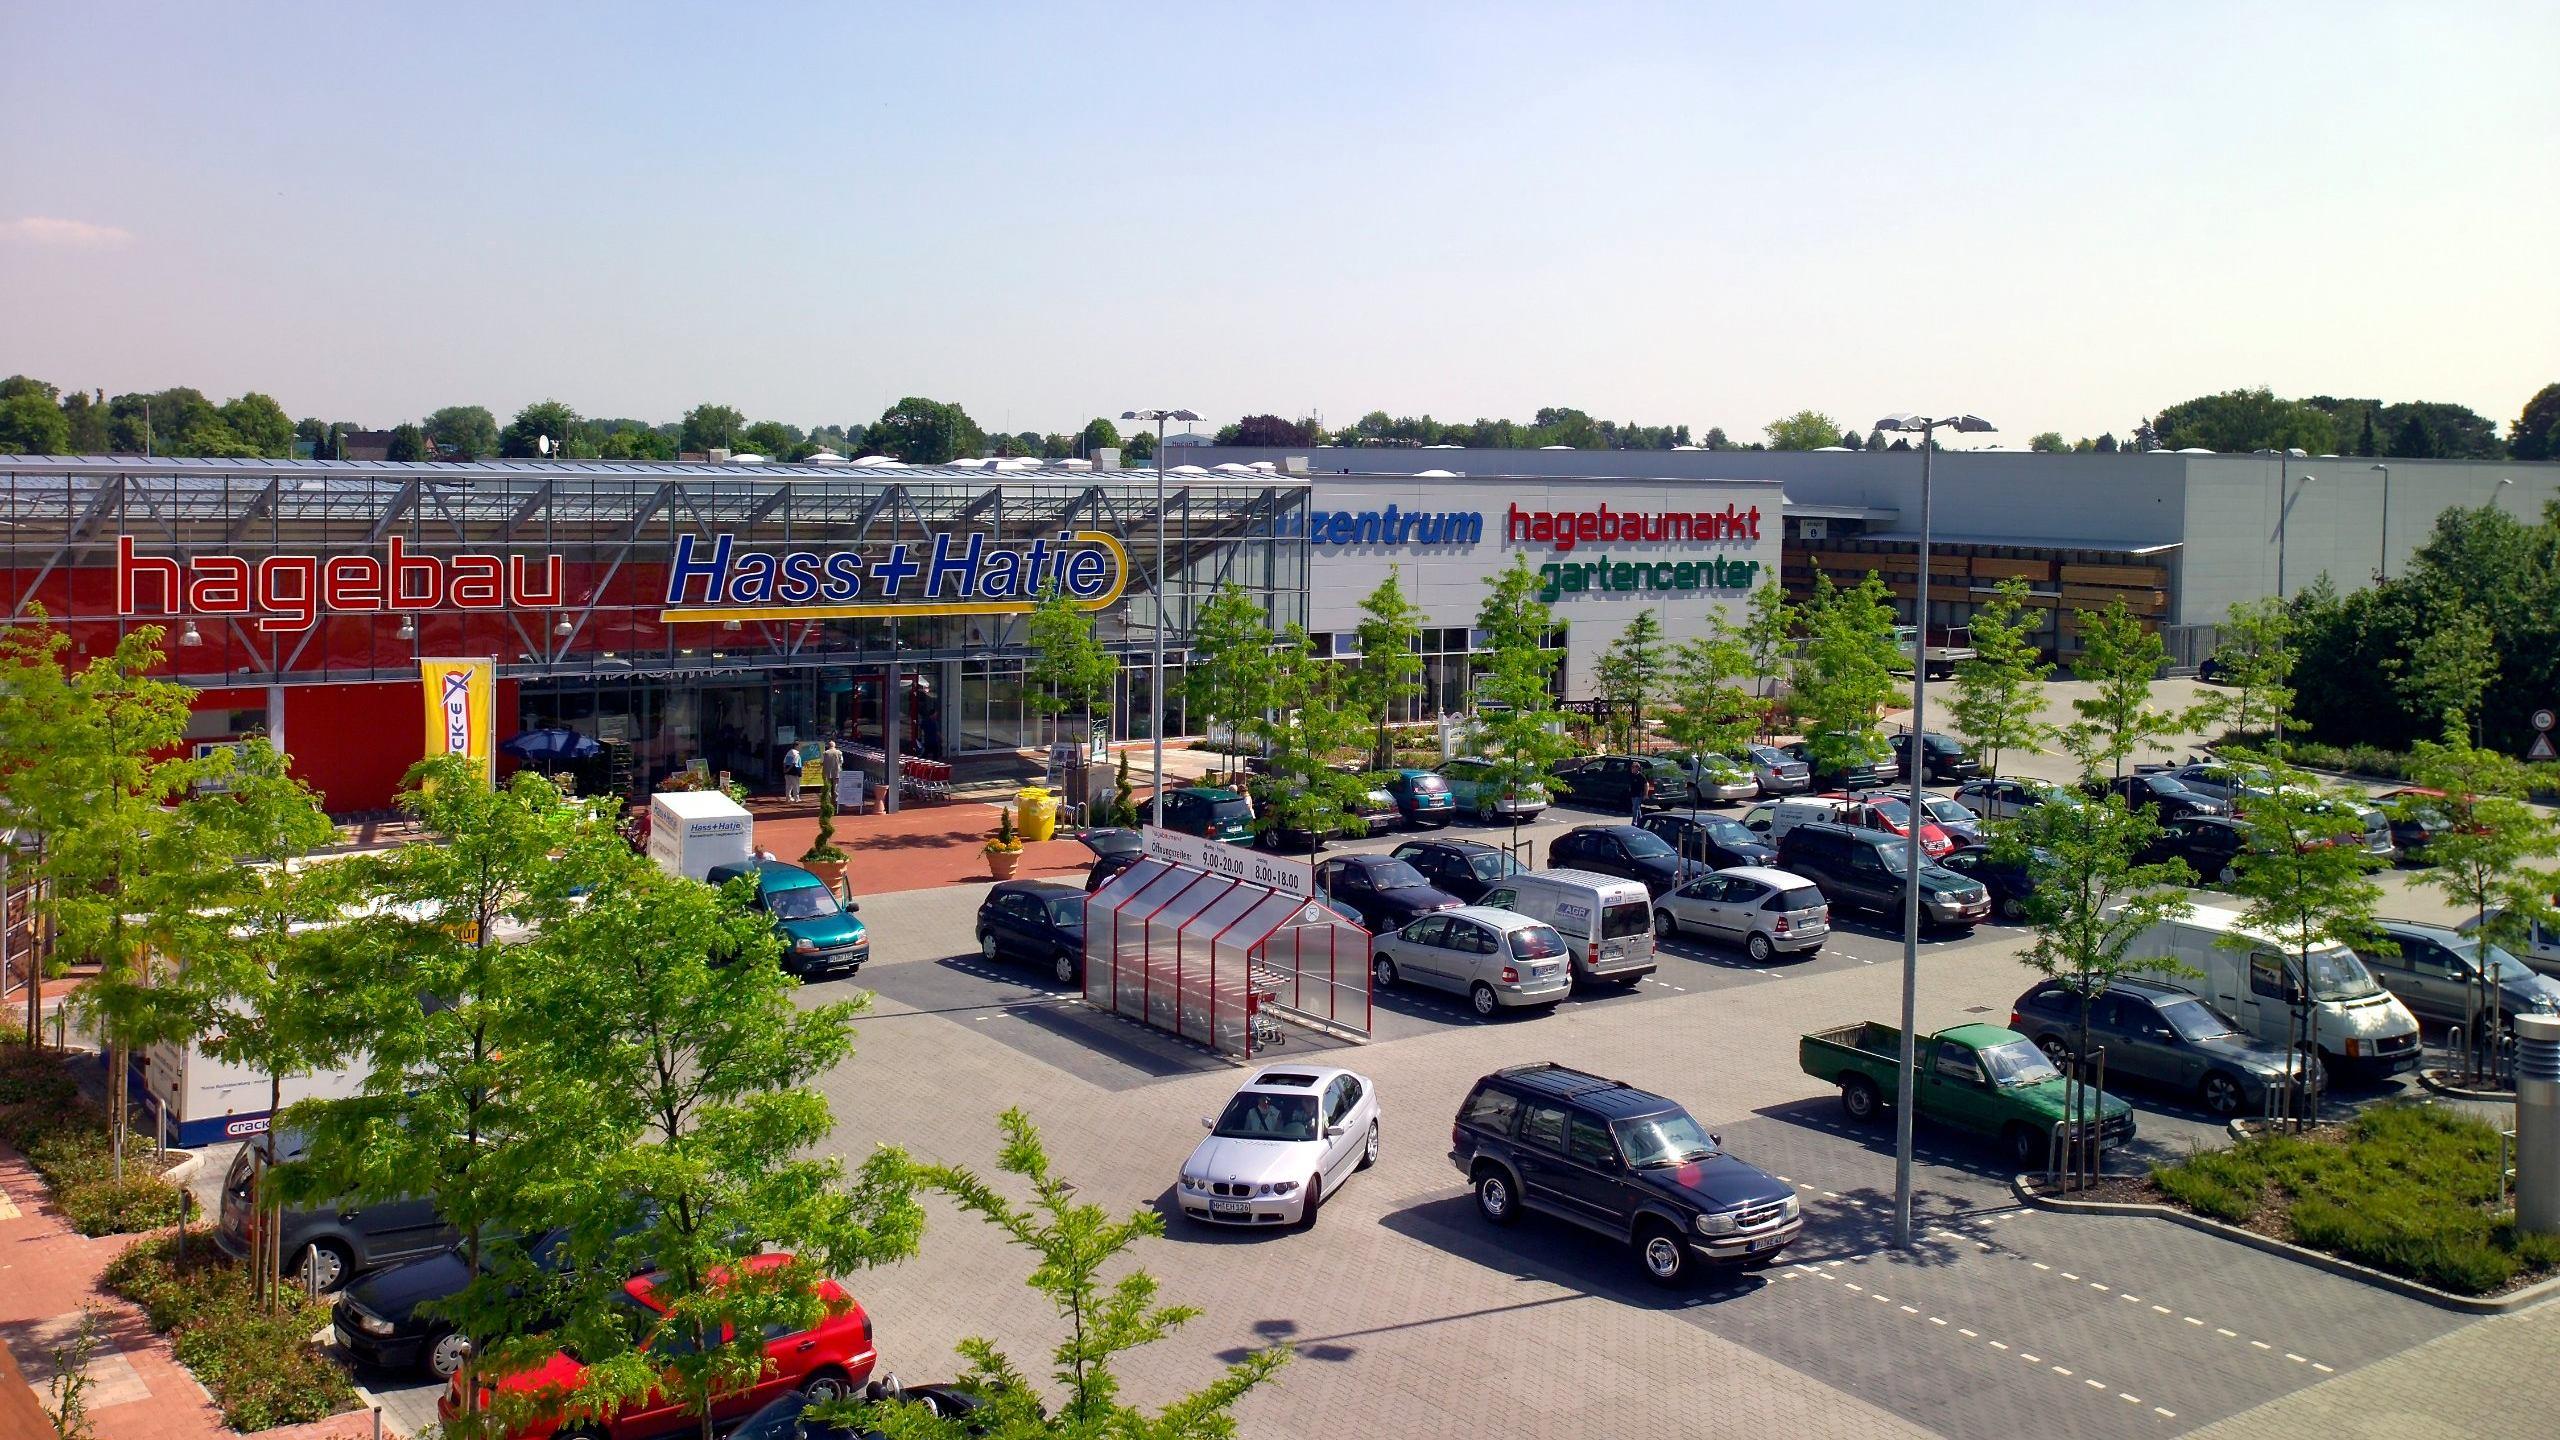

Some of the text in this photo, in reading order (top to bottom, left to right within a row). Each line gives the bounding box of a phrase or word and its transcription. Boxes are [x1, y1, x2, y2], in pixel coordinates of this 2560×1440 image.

[1510, 502, 1761, 551] hagebaumarkt
[117, 535, 563, 632] hagebau
[1539, 554, 1760, 602] gartencenter
